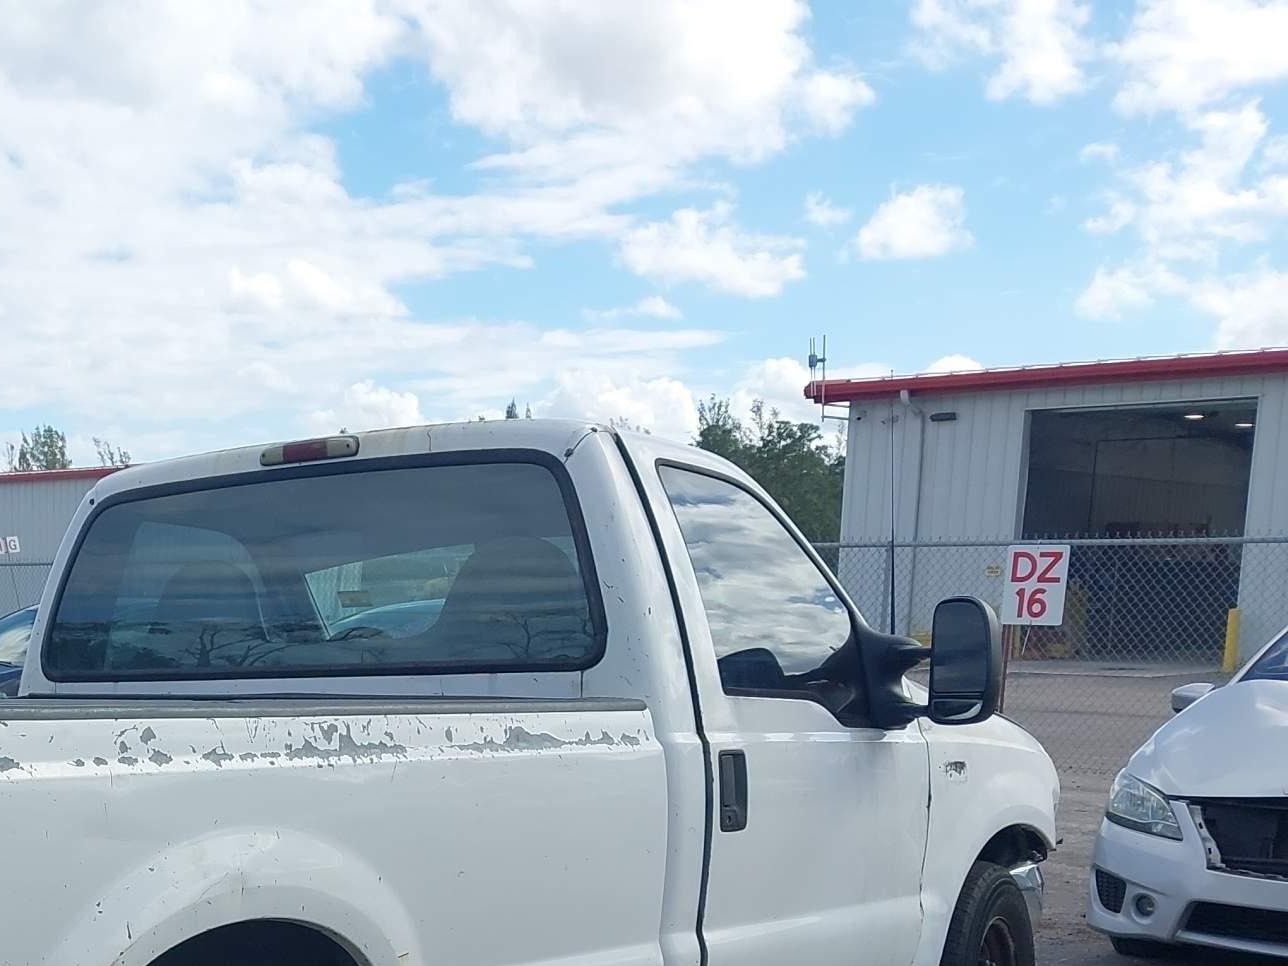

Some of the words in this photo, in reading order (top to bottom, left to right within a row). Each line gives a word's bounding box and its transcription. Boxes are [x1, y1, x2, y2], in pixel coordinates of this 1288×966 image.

[9, 540, 17, 551] G
[1011, 552, 1064, 583] DZ
[1016, 588, 1047, 618] 16
